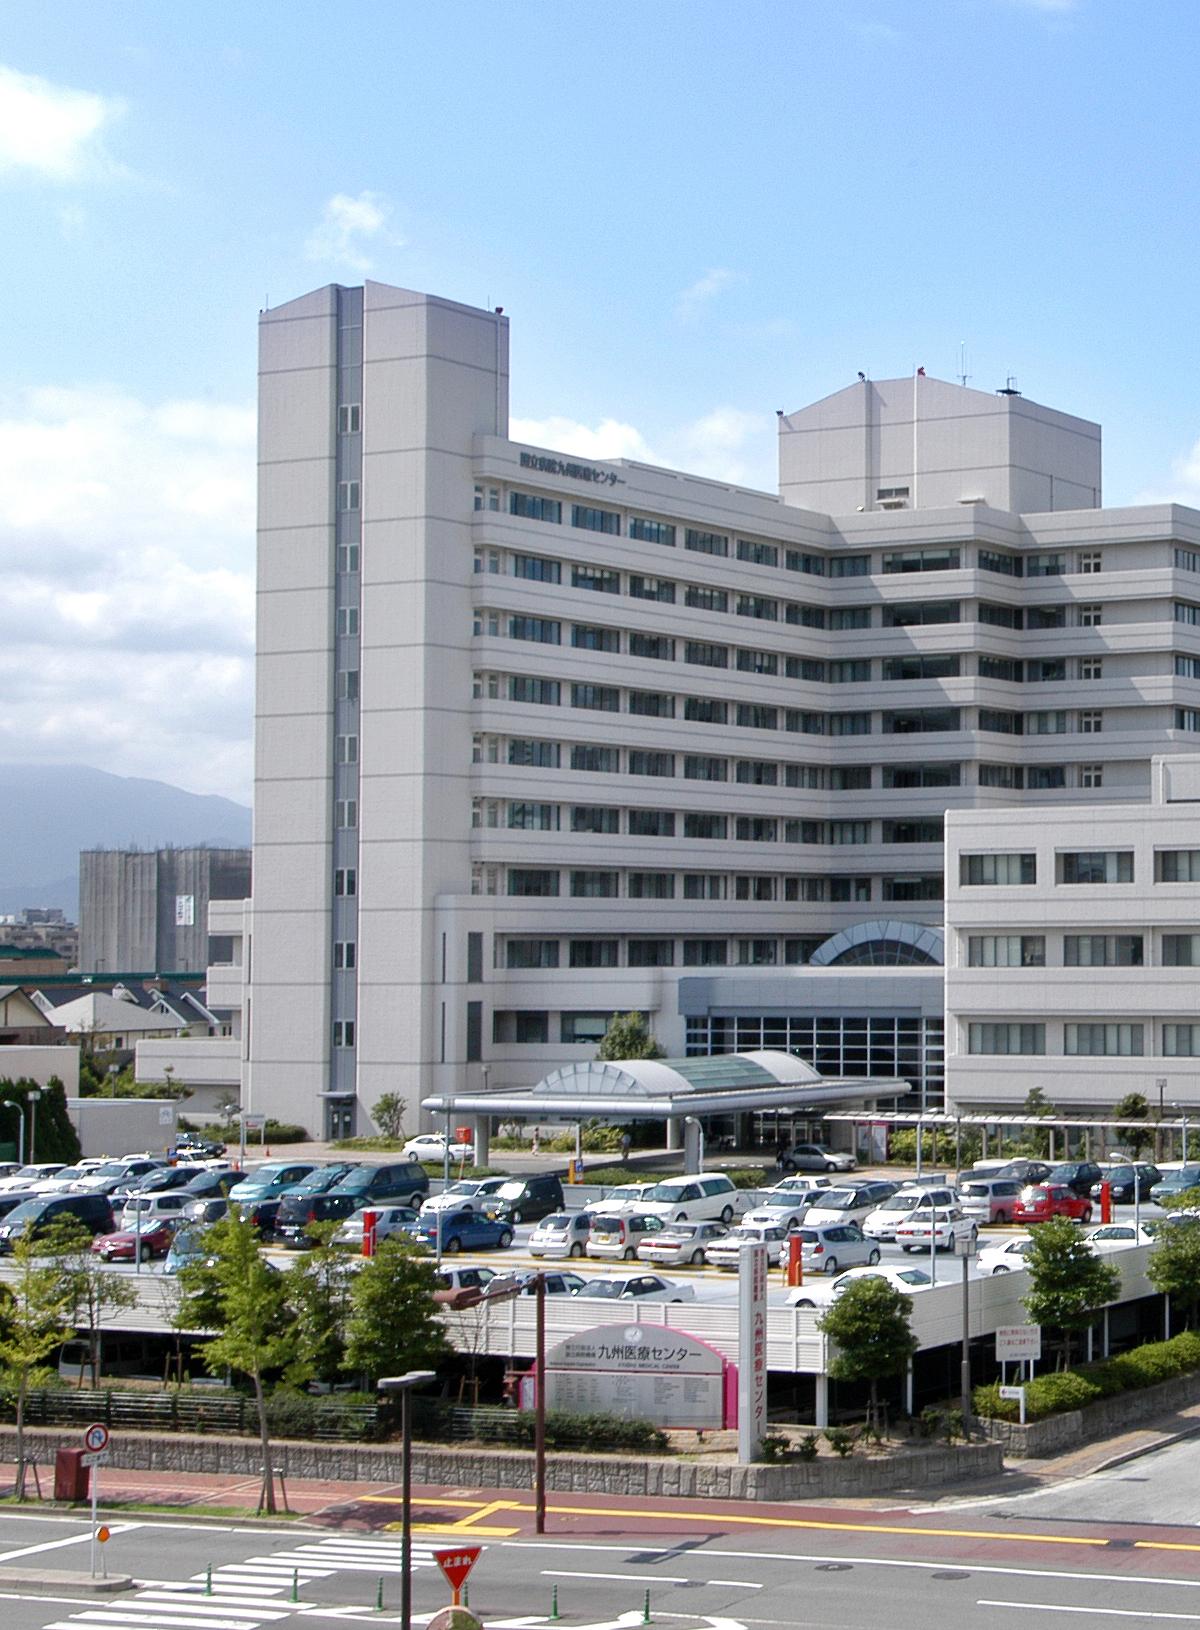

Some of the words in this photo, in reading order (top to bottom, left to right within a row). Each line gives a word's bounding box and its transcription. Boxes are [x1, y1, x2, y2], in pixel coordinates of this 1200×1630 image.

[598, 1344, 702, 1361] 九州医療センター
[754, 1312, 764, 1434] 九州医療センター
[443, 1555, 472, 1568] 止まれ
